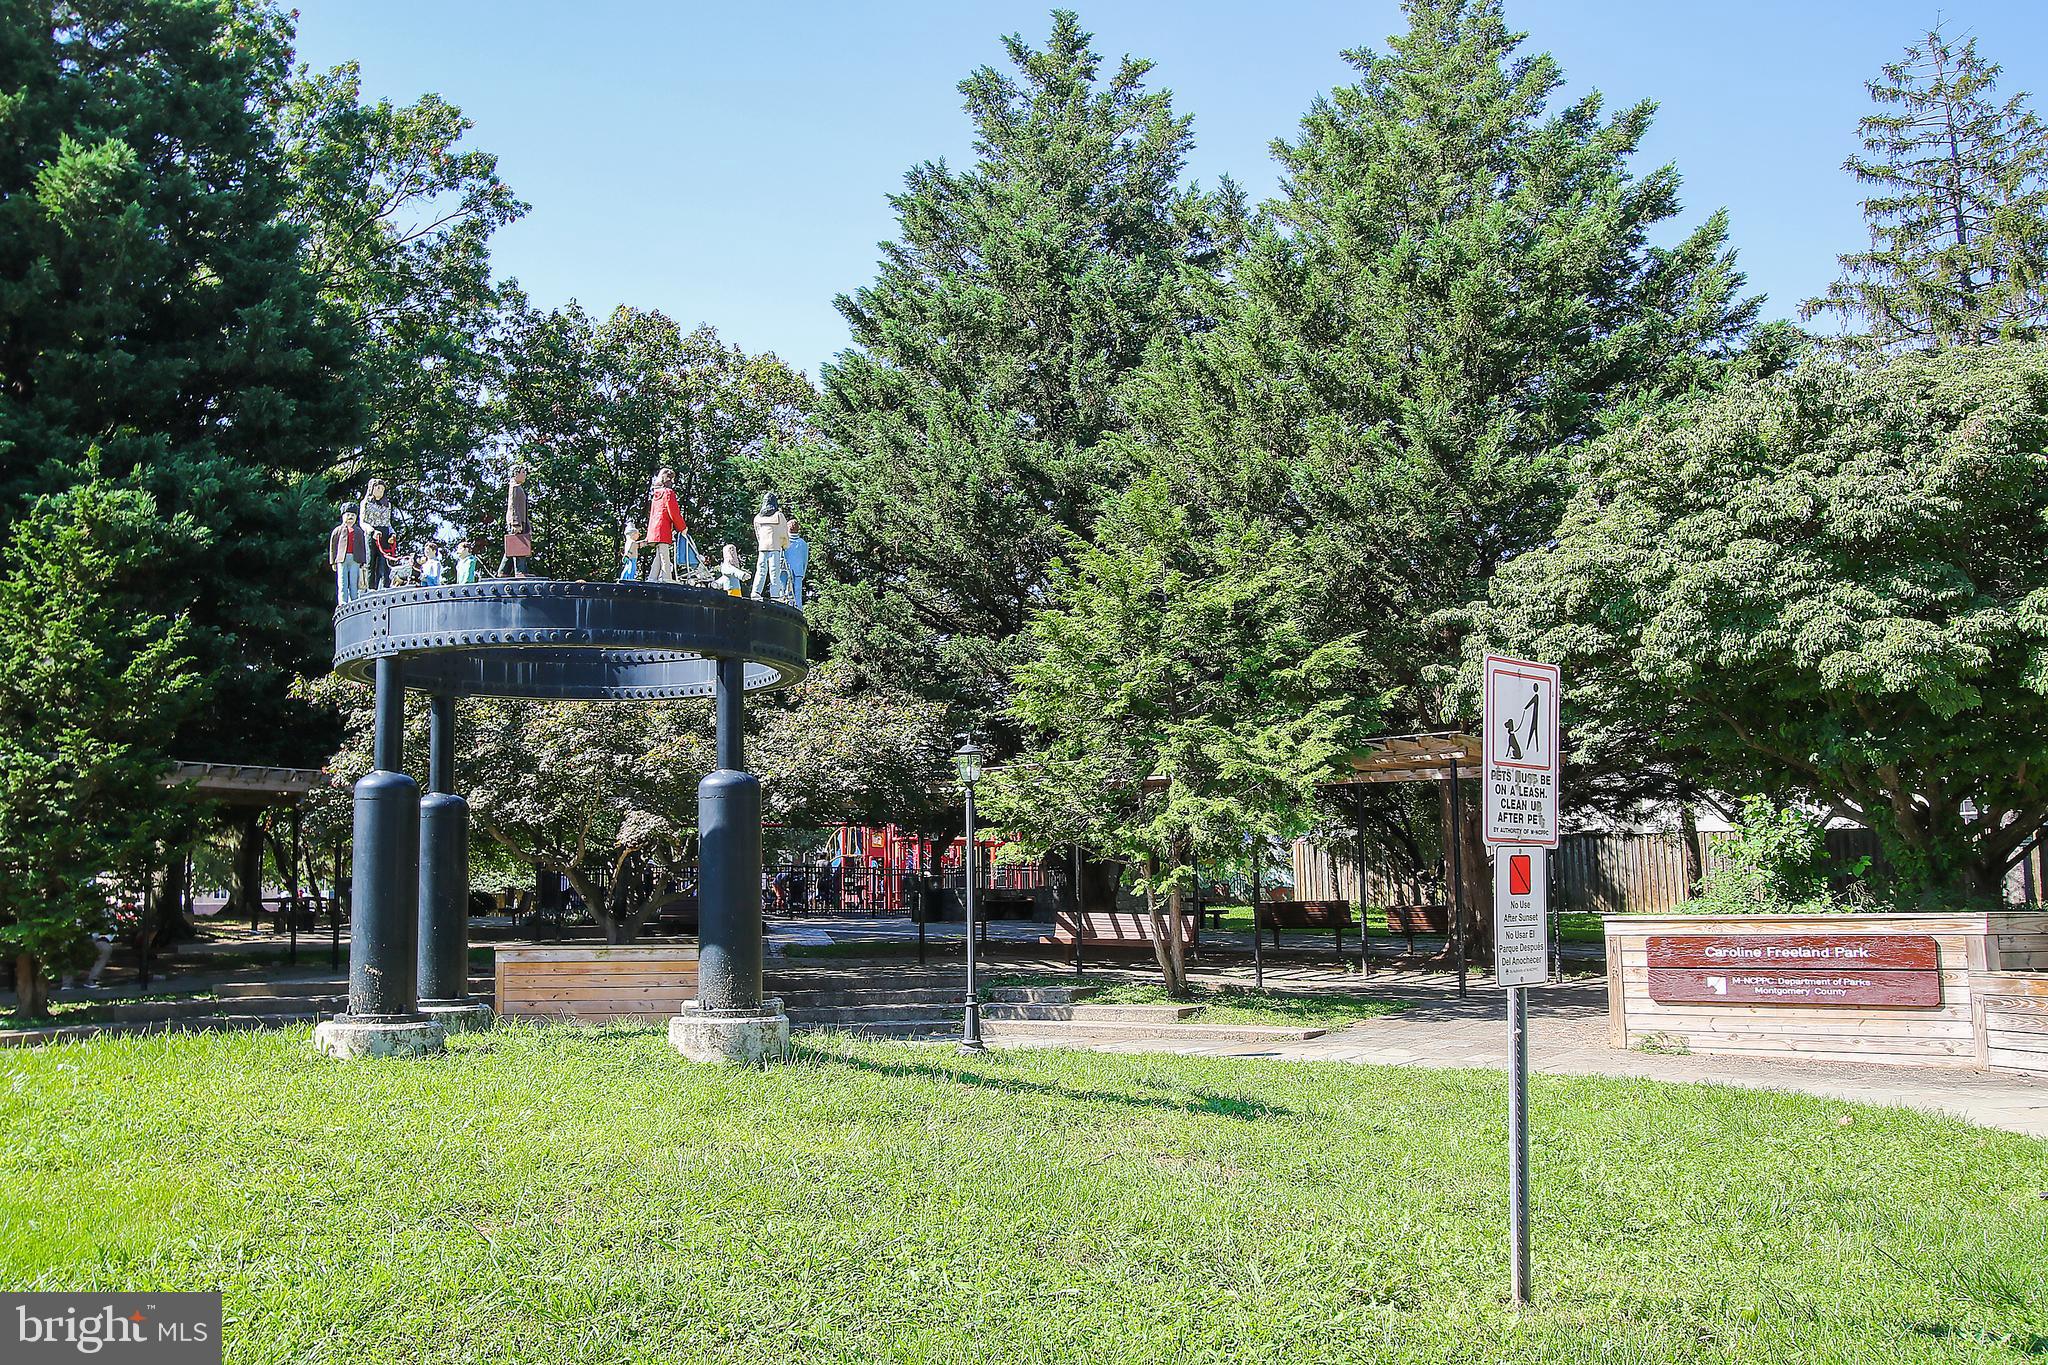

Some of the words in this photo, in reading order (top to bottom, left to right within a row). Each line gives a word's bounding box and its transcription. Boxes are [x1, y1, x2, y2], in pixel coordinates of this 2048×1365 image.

[1491, 770, 1511, 781] PETS
[1541, 775, 1551, 785] BE
[1495, 784, 1506, 795] ON
[1510, 786, 1515, 796] A
[1519, 786, 1547, 798] LEASH.
[1501, 798, 1527, 810] CLEAN
[1498, 812, 1523, 824] AFTER
[1528, 814, 1545, 826] PE
[1510, 901, 1518, 909] No
[1504, 914, 1518, 922] After
[1518, 913, 1538, 922] Sunset
[1506, 932, 1514, 940] No
[1515, 930, 1528, 939] Usar
[1529, 930, 1535, 938] El
[1499, 944, 1519, 954] Parque
[1520, 942, 1544, 953] Después
[1704, 946, 1761, 958] Caroline
[1767, 946, 1830, 958] Freeland
[1835, 946, 1869, 958] Park
[1502, 957, 1511, 966] Del
[1512, 956, 1542, 965] Anochecer
[1777, 978, 1831, 987] Department
[1832, 978, 1842, 986] of
[1843, 978, 1870, 986] Parks
[1754, 987, 1810, 996] Montgomery
[1814, 987, 1847, 996] County
